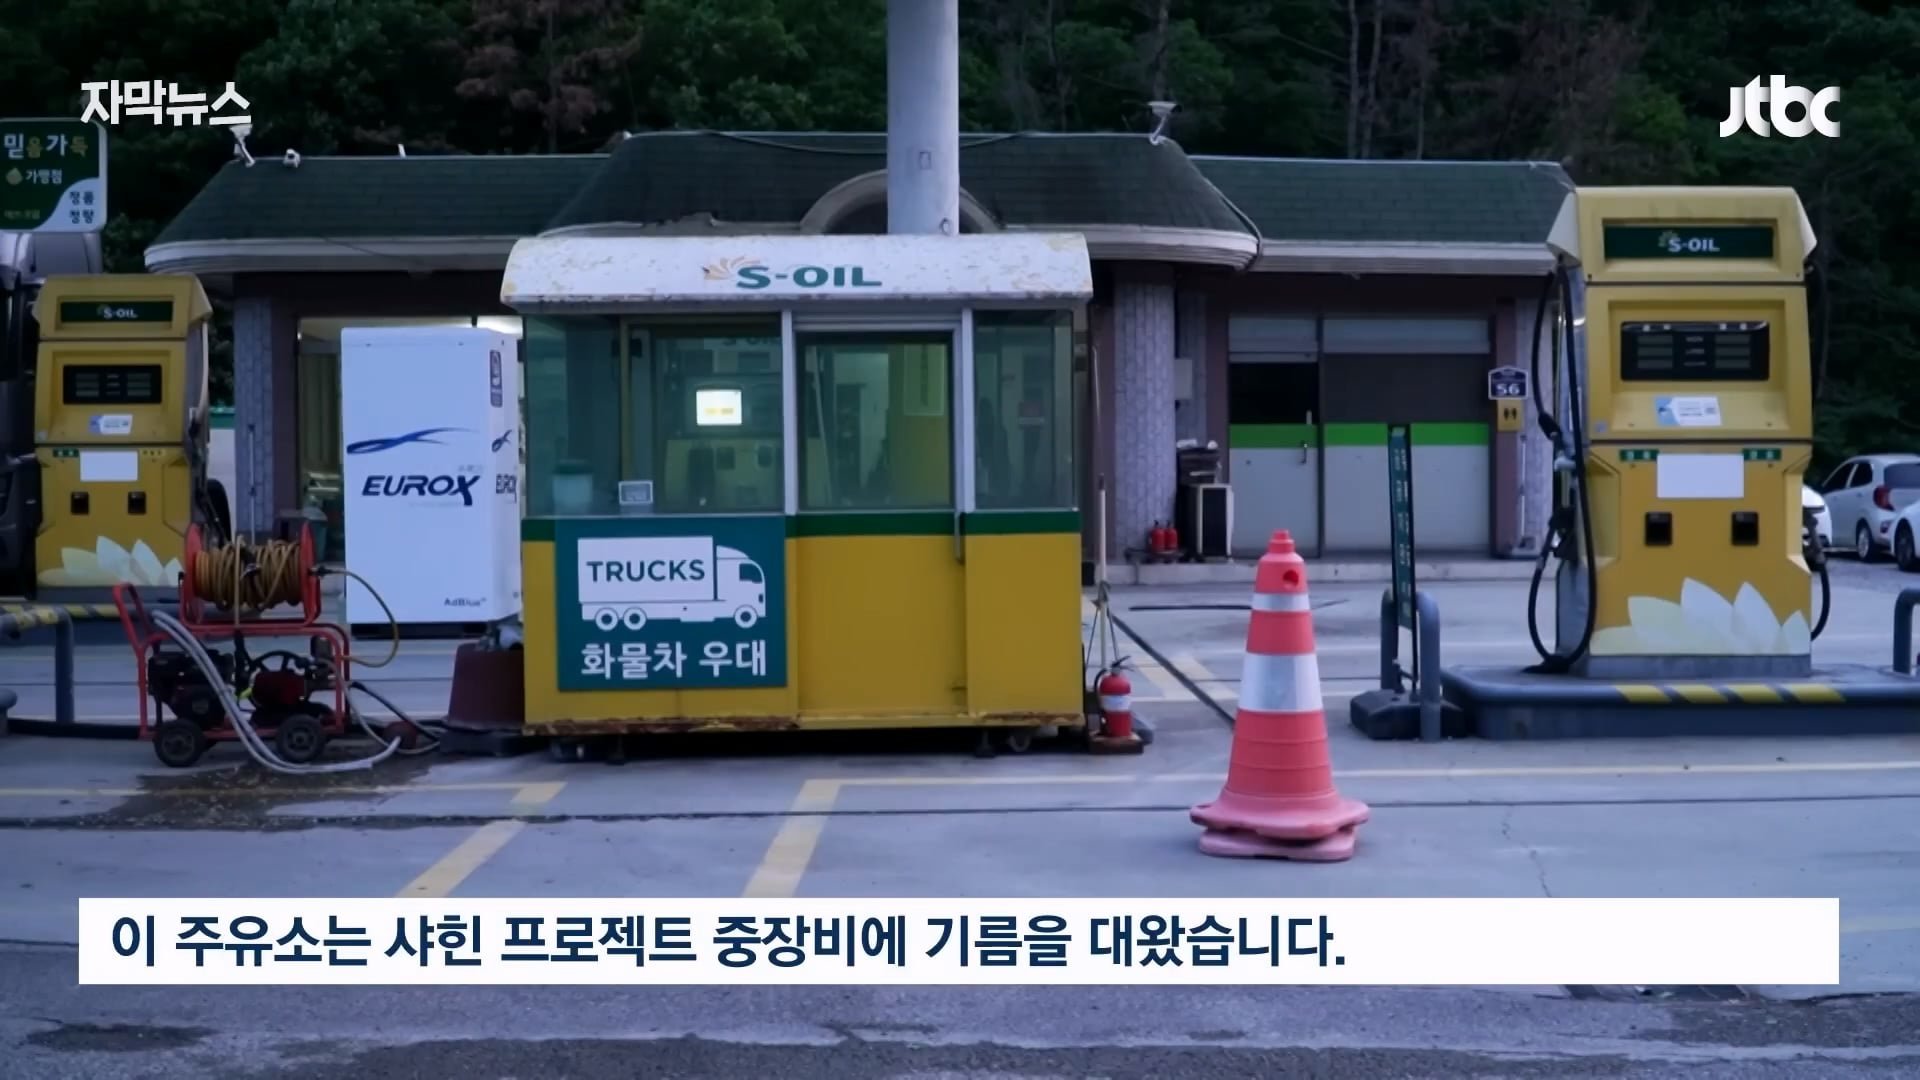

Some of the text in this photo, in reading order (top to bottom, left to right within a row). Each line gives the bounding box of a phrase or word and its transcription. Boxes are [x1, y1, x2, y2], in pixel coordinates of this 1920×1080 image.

[1667, 237, 1720, 252] S-OIL
[736, 266, 883, 289] S-OIL
[103, 307, 138, 319] S-OIL
[362, 475, 480, 506] EUROX
[586, 559, 706, 583] TRUCKS
[581, 639, 766, 680] 화물차 우대
